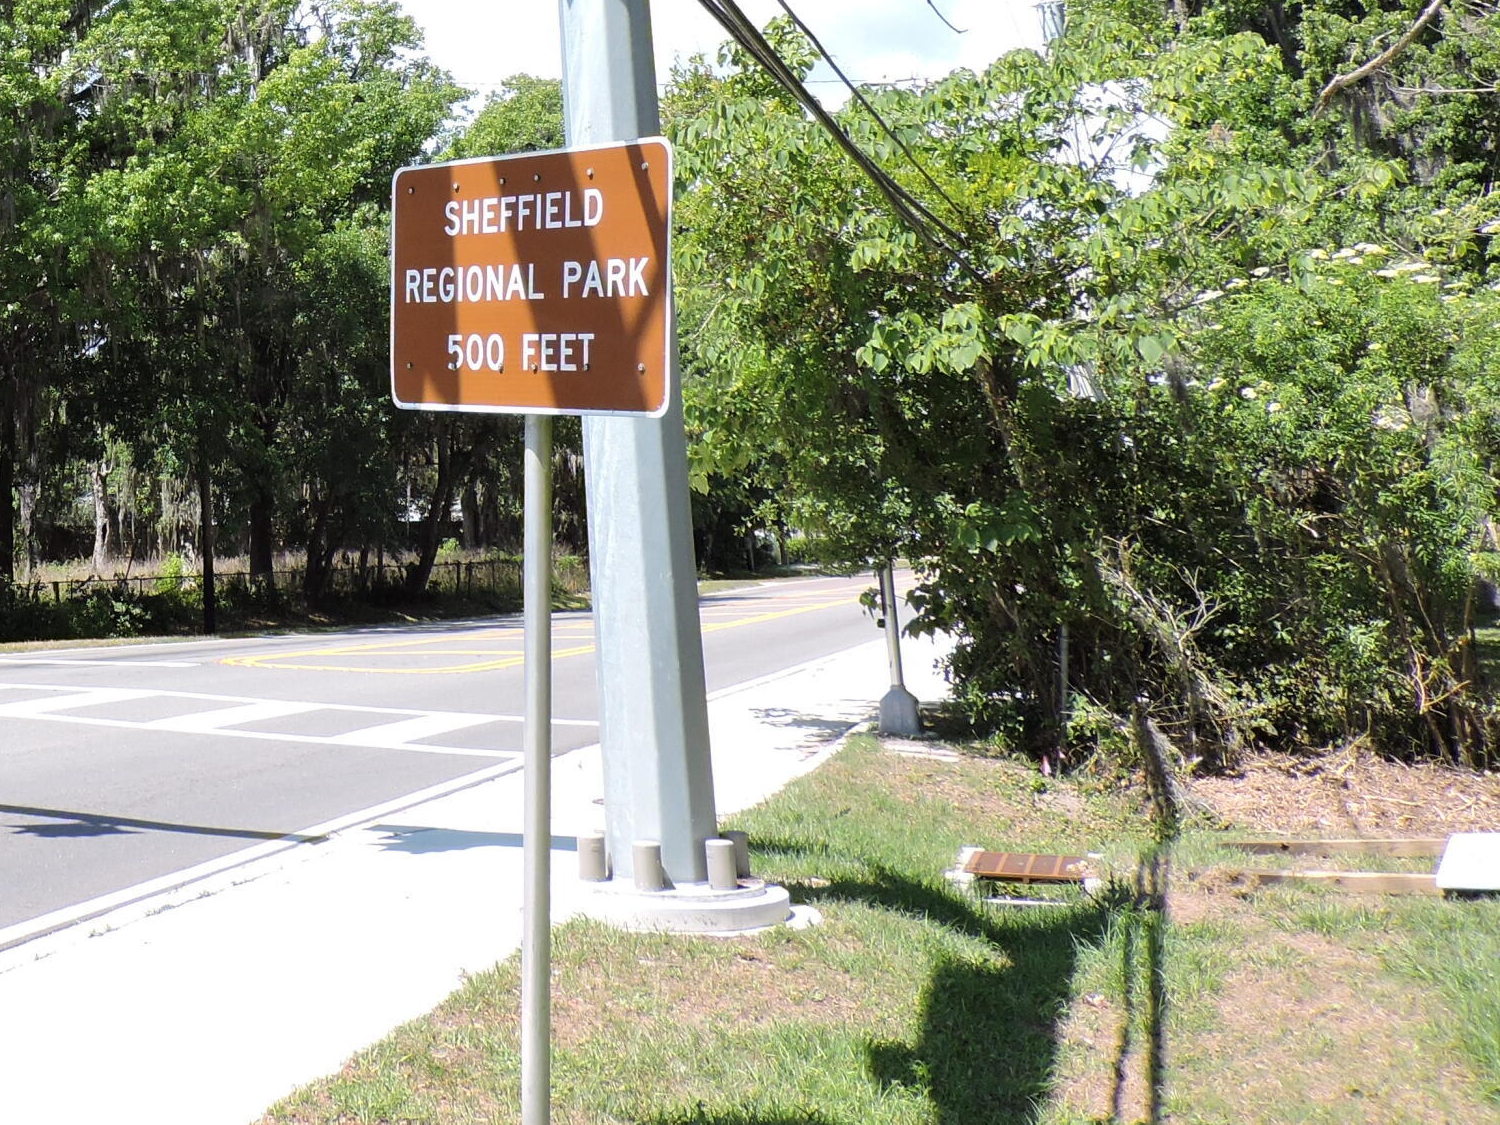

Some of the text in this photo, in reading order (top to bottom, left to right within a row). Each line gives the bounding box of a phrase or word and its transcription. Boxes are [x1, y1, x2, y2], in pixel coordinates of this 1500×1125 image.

[444, 188, 603, 236] SHEFFIELD
[405, 257, 650, 303] REGIONAL PARK
[447, 333, 595, 372] 500 FEET
